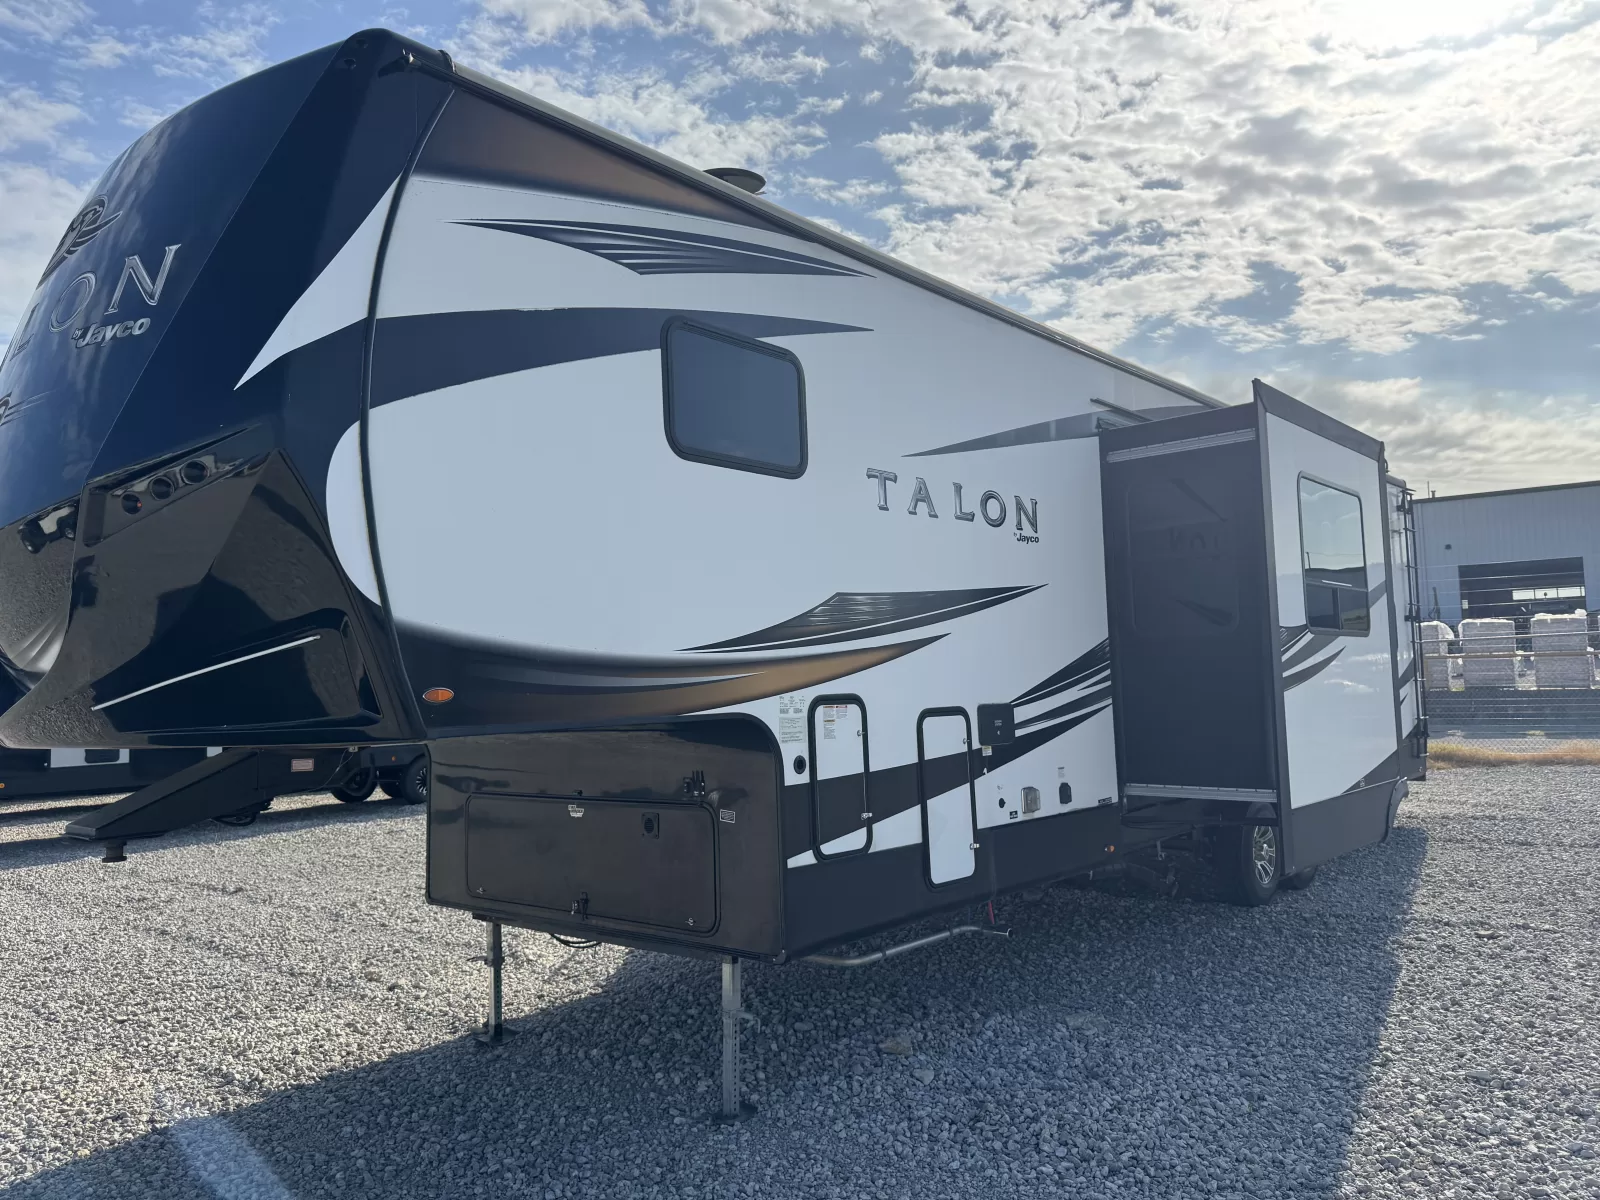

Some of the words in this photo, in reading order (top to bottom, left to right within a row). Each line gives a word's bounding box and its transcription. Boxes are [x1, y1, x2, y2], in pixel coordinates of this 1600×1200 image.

[0, 244, 182, 364] LON
[76, 318, 151, 348] Jayco
[866, 467, 1038, 534] TALON
[1017, 533, 1040, 544] Jayco
